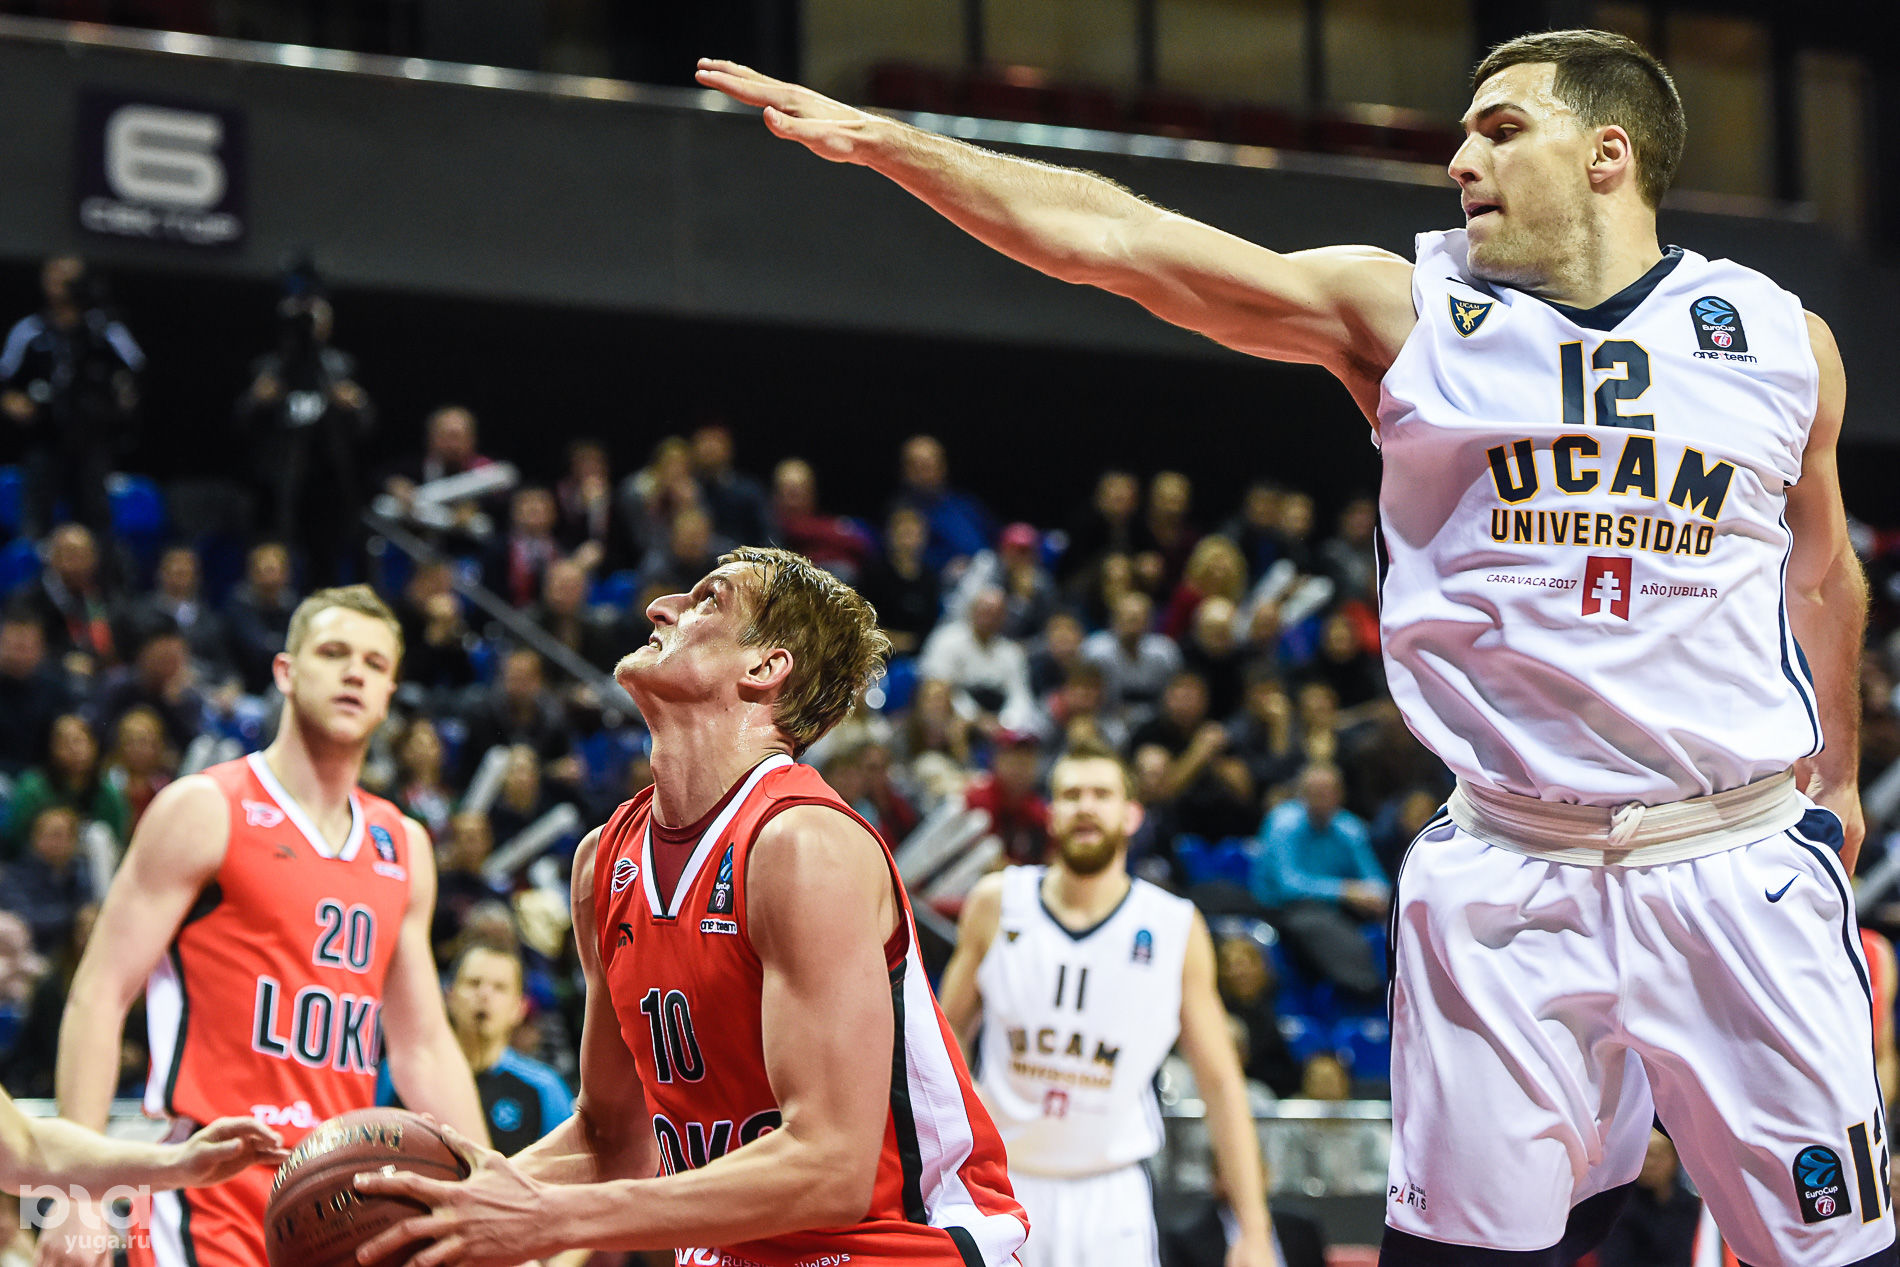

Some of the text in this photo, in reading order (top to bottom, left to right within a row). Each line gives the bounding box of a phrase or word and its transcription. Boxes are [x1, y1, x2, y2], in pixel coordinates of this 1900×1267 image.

[104, 103, 228, 207] 6
[1459, 302, 1480, 310] UCAM
[1702, 324, 1736, 333] EuroCup
[1693, 351, 1719, 360] one
[1558, 339, 1656, 432] 12
[1487, 433, 1737, 524] UCAM
[1490, 508, 1716, 557] UNIVERSIDAD
[1486, 574, 1718, 599] CARAVACA 2017 AÑO JUBILAR
[313, 898, 377, 974] 20
[1054, 963, 1088, 1012] 11
[252, 974, 383, 1076] LOK
[641, 987, 706, 1084] 10
[1007, 1027, 1120, 1068] UCAM
[1804, 1185, 1838, 1199] EuroCup
